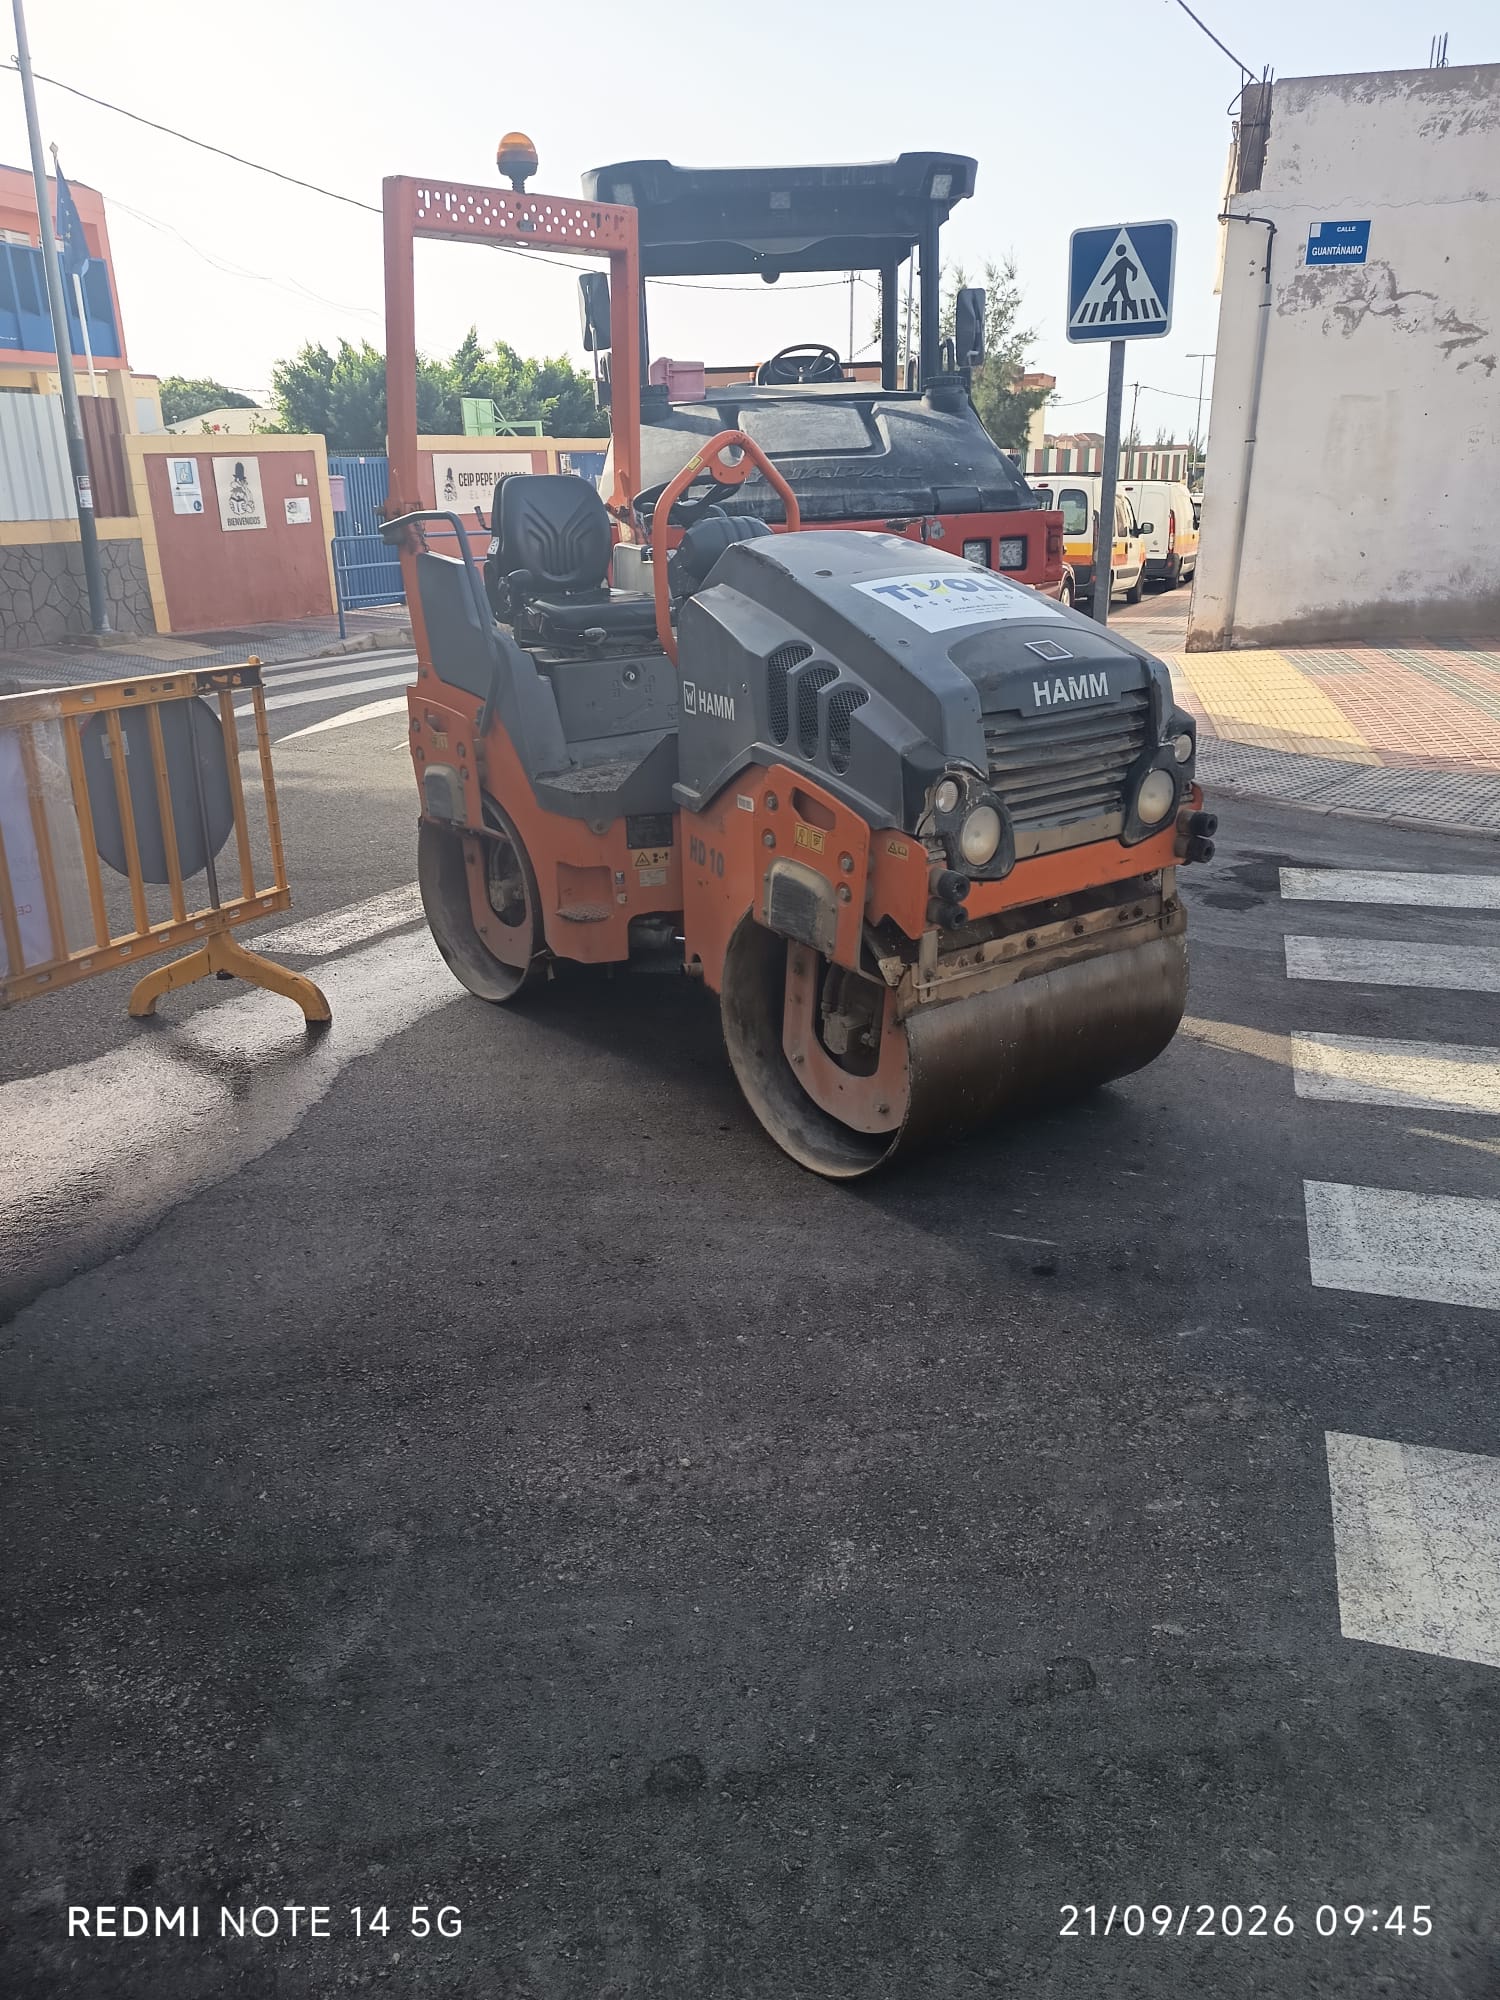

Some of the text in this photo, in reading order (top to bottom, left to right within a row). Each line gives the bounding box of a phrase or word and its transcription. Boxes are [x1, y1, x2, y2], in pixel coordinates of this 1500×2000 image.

[1311, 243, 1363, 256] GUANTÁNAMO
[458, 472, 475, 487] CEIP
[475, 472, 493, 487] PEPE
[699, 689, 735, 721] HAMM
[1032, 672, 1109, 707] HAMM
[690, 834, 724, 879] HD 10
